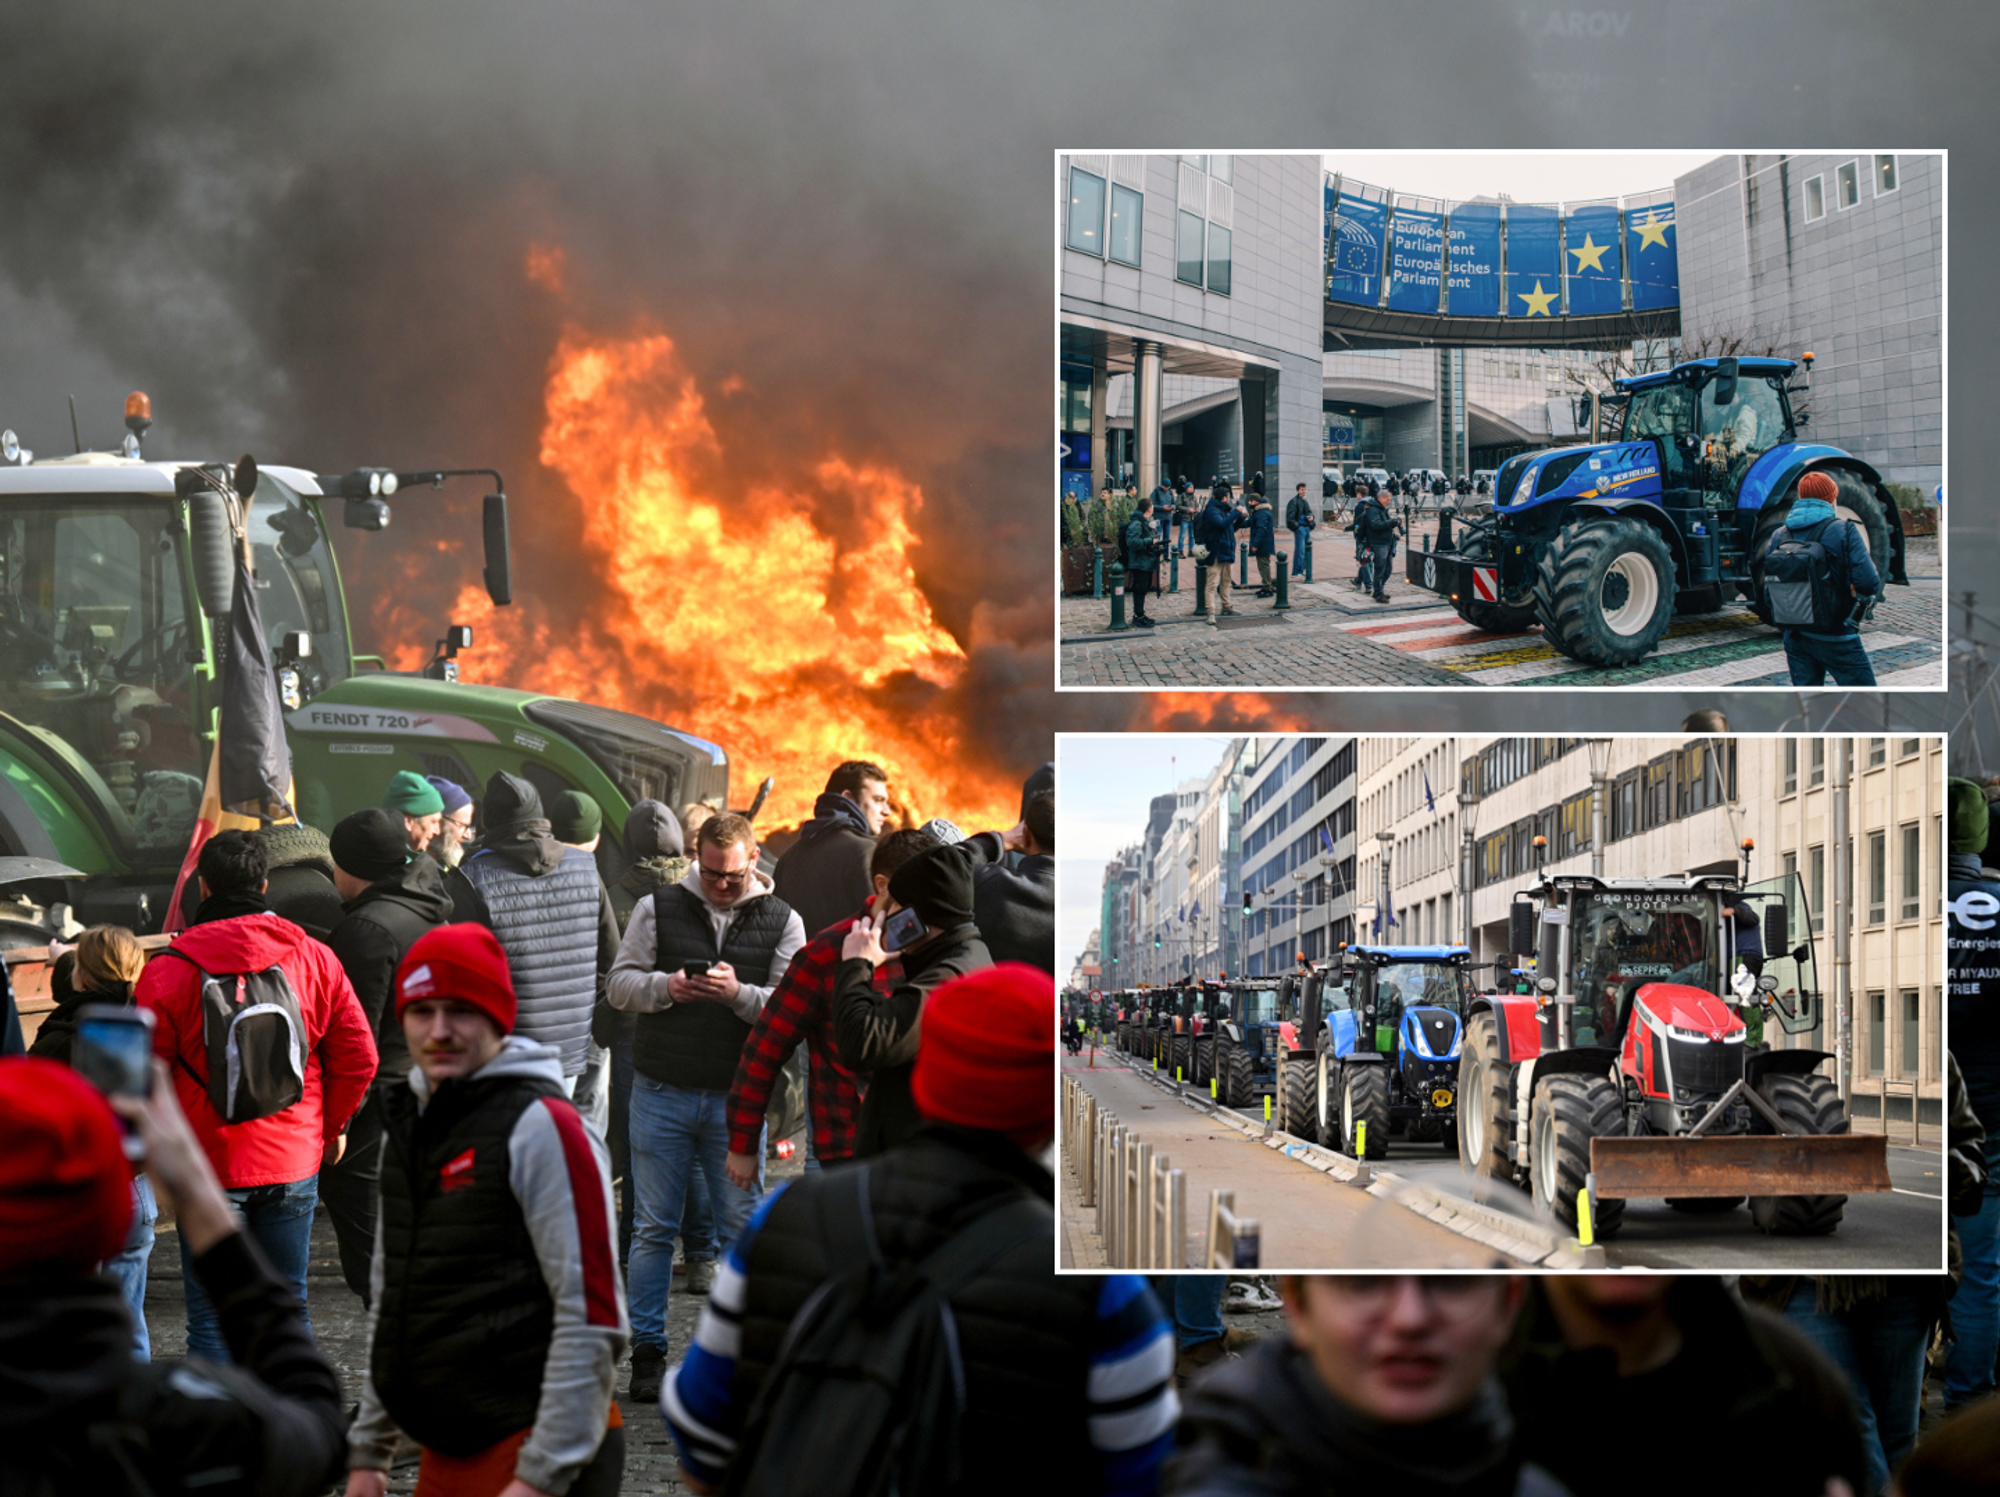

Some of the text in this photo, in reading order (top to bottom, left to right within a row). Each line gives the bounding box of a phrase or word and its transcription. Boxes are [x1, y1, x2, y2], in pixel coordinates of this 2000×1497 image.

[1395, 220, 1466, 240] European
[1395, 236, 1475, 255] Parliament
[1394, 254, 1490, 274] Europäisches
[1393, 269, 1470, 288] Parlament
[311, 712, 370, 726] FENDT
[376, 715, 409, 728] 720
[1594, 894, 1698, 902] GRONDWERKEN
[1626, 901, 1668, 910] PJOTR
[1633, 965, 1659, 975] SEPPE
